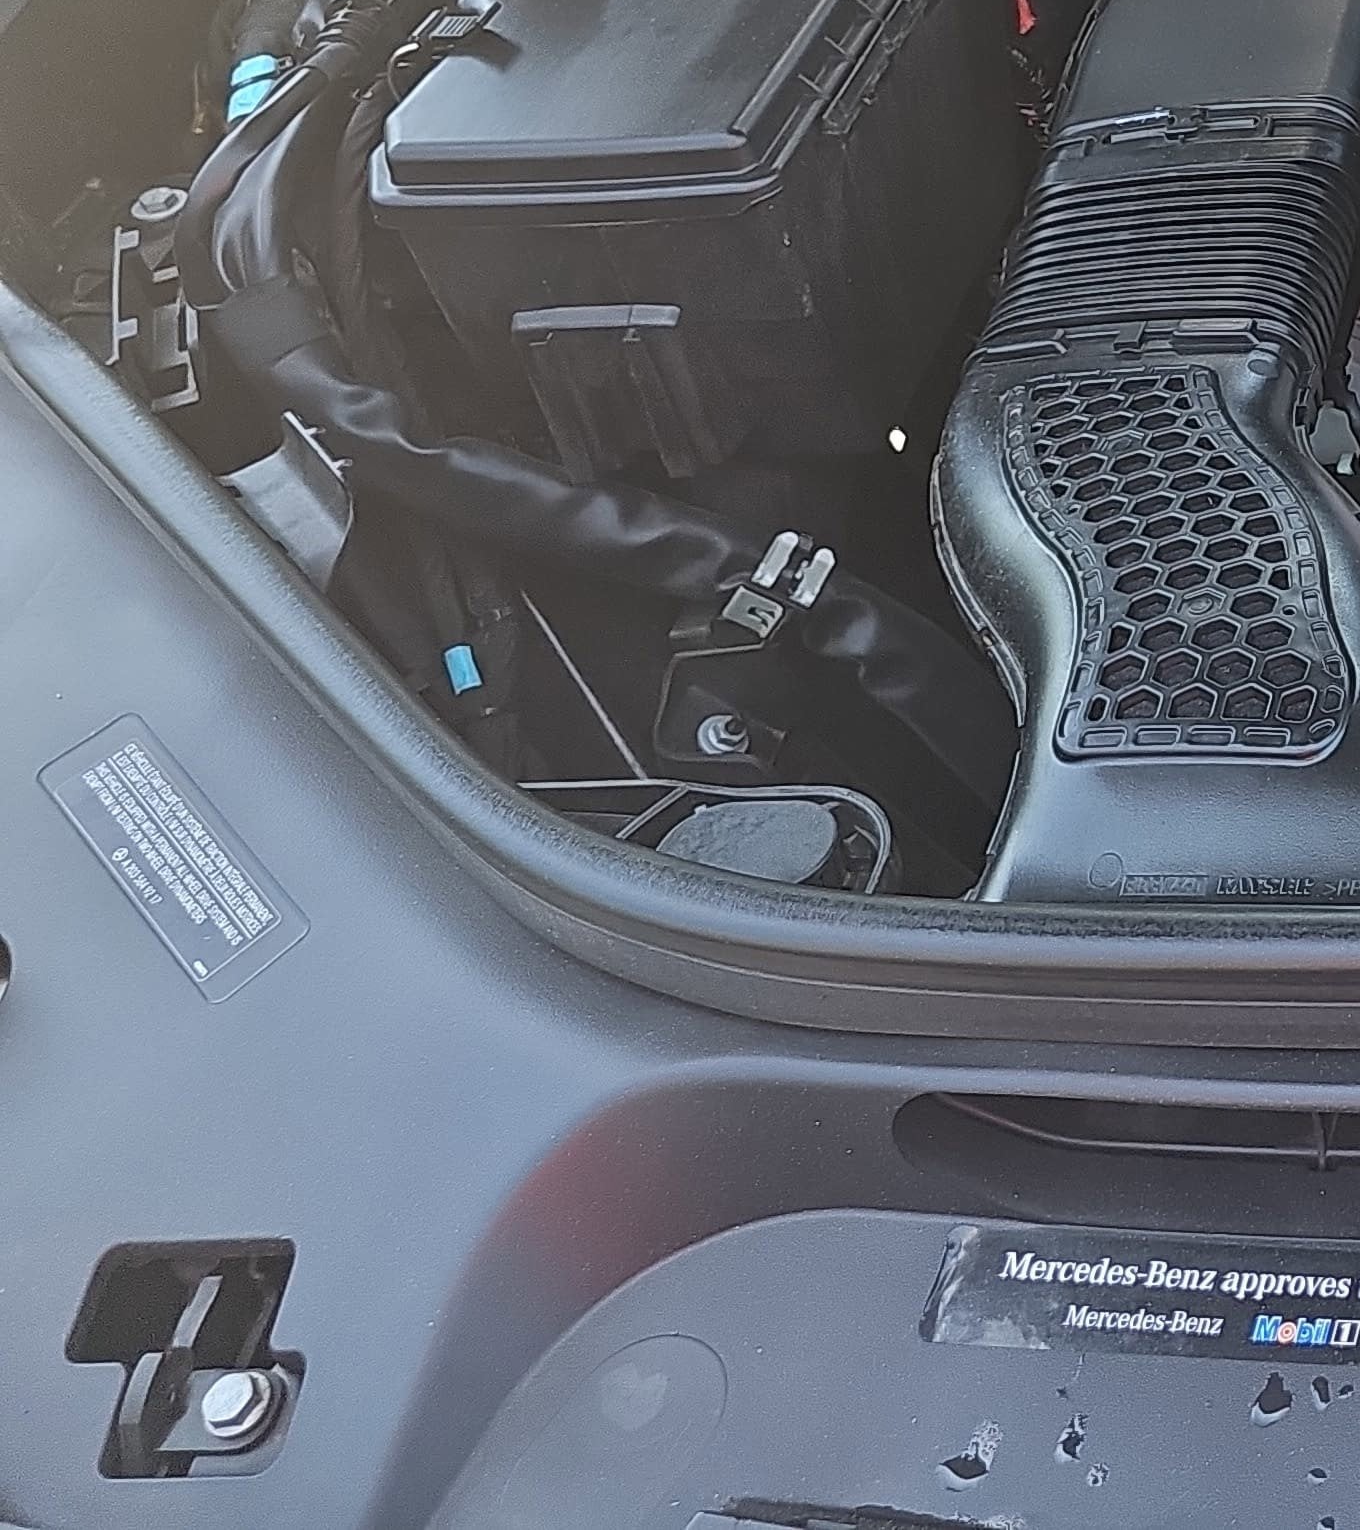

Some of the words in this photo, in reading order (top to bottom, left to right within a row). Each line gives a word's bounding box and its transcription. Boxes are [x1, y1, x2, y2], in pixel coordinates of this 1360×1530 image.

[998, 1251, 1215, 1295] Mercedes-Benz
[1221, 1270, 1352, 1302] approves
[1062, 1304, 1223, 1336] Mercedes-Benz
[1250, 1315, 1332, 1346] Mobil
